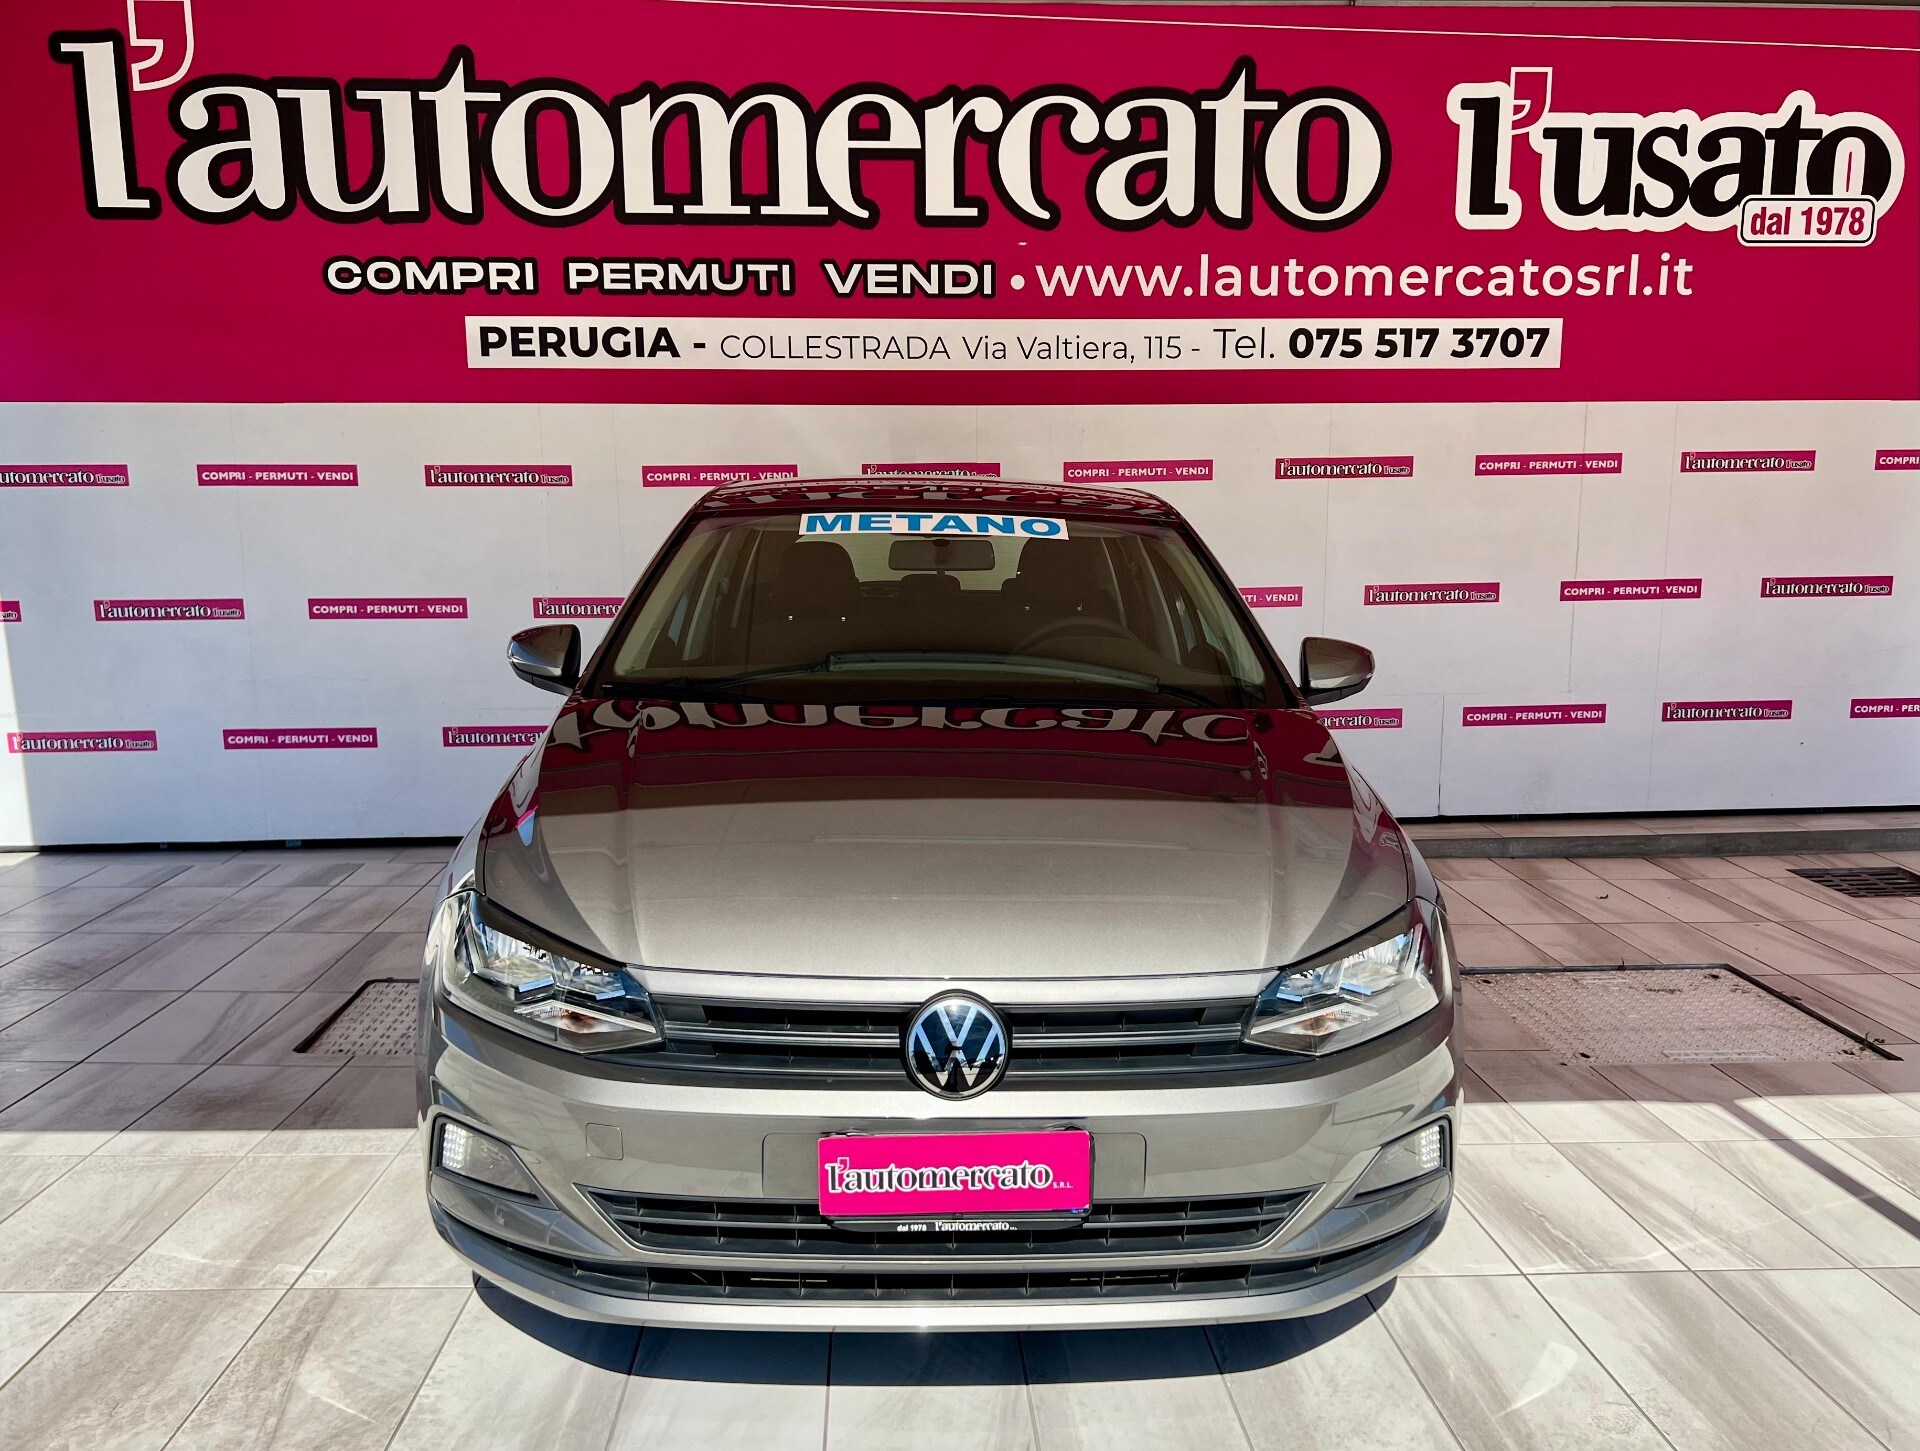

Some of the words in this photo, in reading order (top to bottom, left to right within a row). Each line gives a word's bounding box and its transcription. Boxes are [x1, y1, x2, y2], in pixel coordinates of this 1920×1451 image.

[56, 0, 1383, 223] l'automercato
[1458, 67, 1894, 219] l'usato
[1750, 208, 1790, 236] dal
[1800, 207, 1866, 236] 1978
[327, 261, 534, 290] COMPRI
[569, 262, 790, 291] PERMUTI
[824, 264, 993, 295] VENDI
[1035, 253, 1694, 297] www.lautomercatosrl.it
[479, 326, 681, 358] PERUGIA
[720, 335, 951, 360] COLLESTRADA
[962, 336, 1007, 360] Via
[1016, 335, 1136, 363] Valtiera,
[1144, 336, 1183, 360] 115
[1213, 326, 1275, 359] Tel.
[1288, 327, 1363, 359] 075
[1375, 327, 1440, 359] 517
[1450, 327, 1551, 359] 3707
[1280, 459, 1384, 476] l'automercato
[1480, 461, 1521, 470] COMPRI
[1530, 460, 1577, 469] PERMUTI
[1585, 459, 1618, 469] VENDI
[1685, 452, 1786, 470] l'automercato
[1880, 456, 1919, 465] COMPRI
[202, 471, 246, 481] COMPRI
[256, 471, 308, 481] PERMUTI
[317, 471, 354, 481] VENDI
[430, 466, 540, 484] l'automercato
[647, 472, 691, 481] COMPRI
[701, 472, 750, 481] PERMUTI
[759, 472, 795, 480] VENDI
[1067, 468, 1110, 477] COMPRI
[1118, 467, 1167, 477] PERMUTI
[1175, 466, 1209, 476] VENDI
[805, 514, 1061, 536] METANO
[1369, 586, 1469, 603] l'automercato
[1564, 587, 1605, 596] COMPRI
[1614, 586, 1660, 595] PERMUTI
[1666, 585, 1698, 594] VENDI
[1766, 578, 1864, 595] l'automercato
[1265, 593, 1299, 602] VENDI
[100, 600, 212, 618] l'automercato
[313, 605, 358, 614] COMPRI
[367, 604, 419, 613] PERMUTI
[428, 604, 464, 613] VENDI
[1467, 713, 1507, 722] COMPRI
[1516, 711, 1562, 721] PERMUTI
[1570, 710, 1603, 720] VENDI
[1666, 702, 1763, 719] l'automercato
[1854, 704, 1894, 713] COMPRI
[12, 732, 124, 750] l'automercato
[228, 735, 269, 744] COMPRI
[278, 735, 329, 744] PERMUTI
[338, 734, 374, 743] VENDI
[825, 1157, 1053, 1193] l'automercato
[1053, 1181, 1074, 1189] S.R.L.
[935, 1221, 1010, 1232] l'automercato
